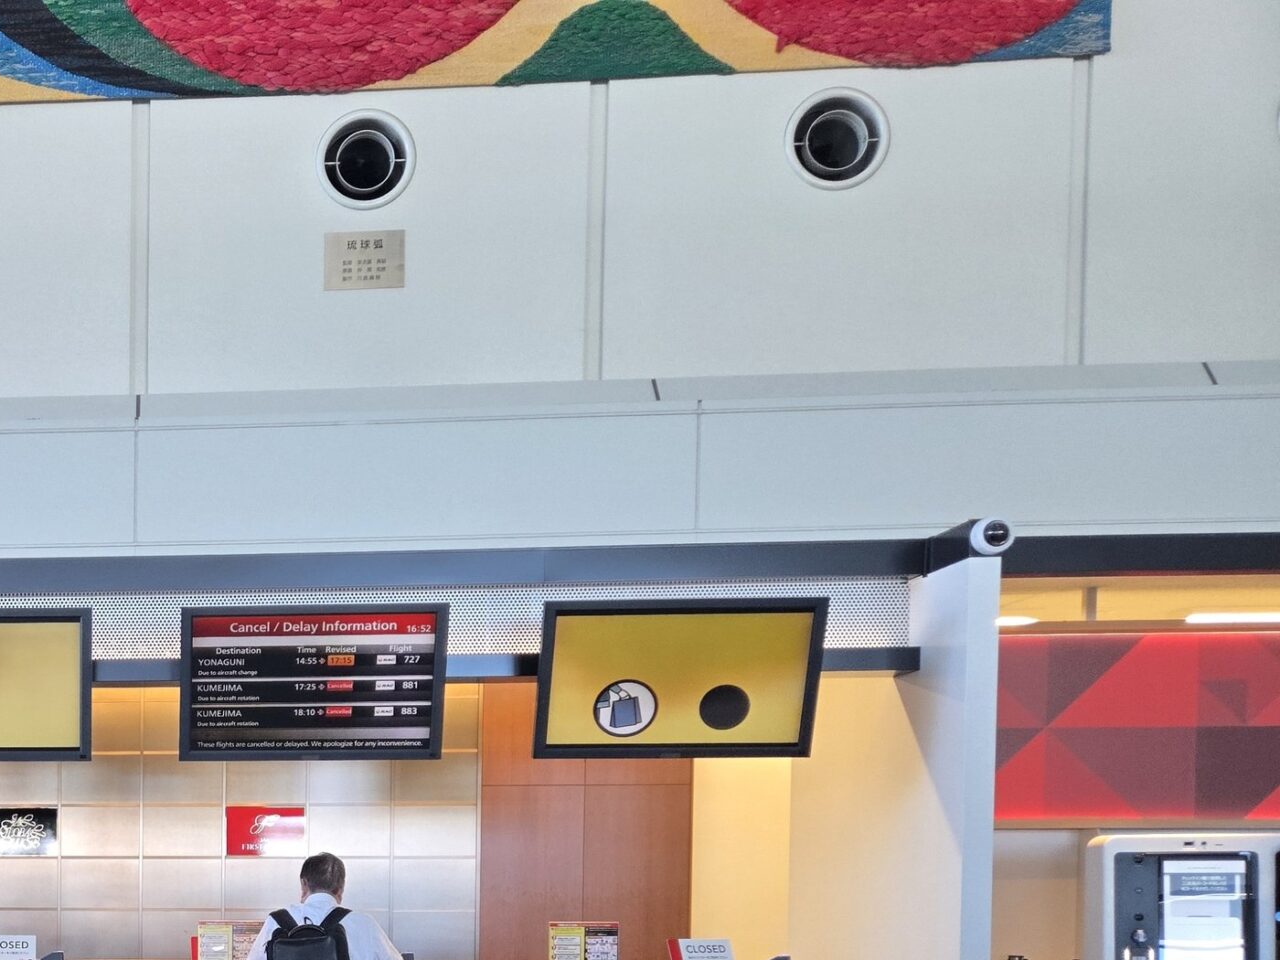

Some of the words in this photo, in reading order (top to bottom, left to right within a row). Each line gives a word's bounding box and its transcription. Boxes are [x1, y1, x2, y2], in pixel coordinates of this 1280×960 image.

[230, 622, 270, 633] Cancel
[273, 622, 280, 633] /
[283, 622, 318, 634] Delay
[322, 620, 398, 632] Information
[406, 624, 432, 633] 16:52
[216, 647, 262, 655] Destination
[389, 644, 412, 654] Flight
[686, 945, 726, 953] CLOSED
